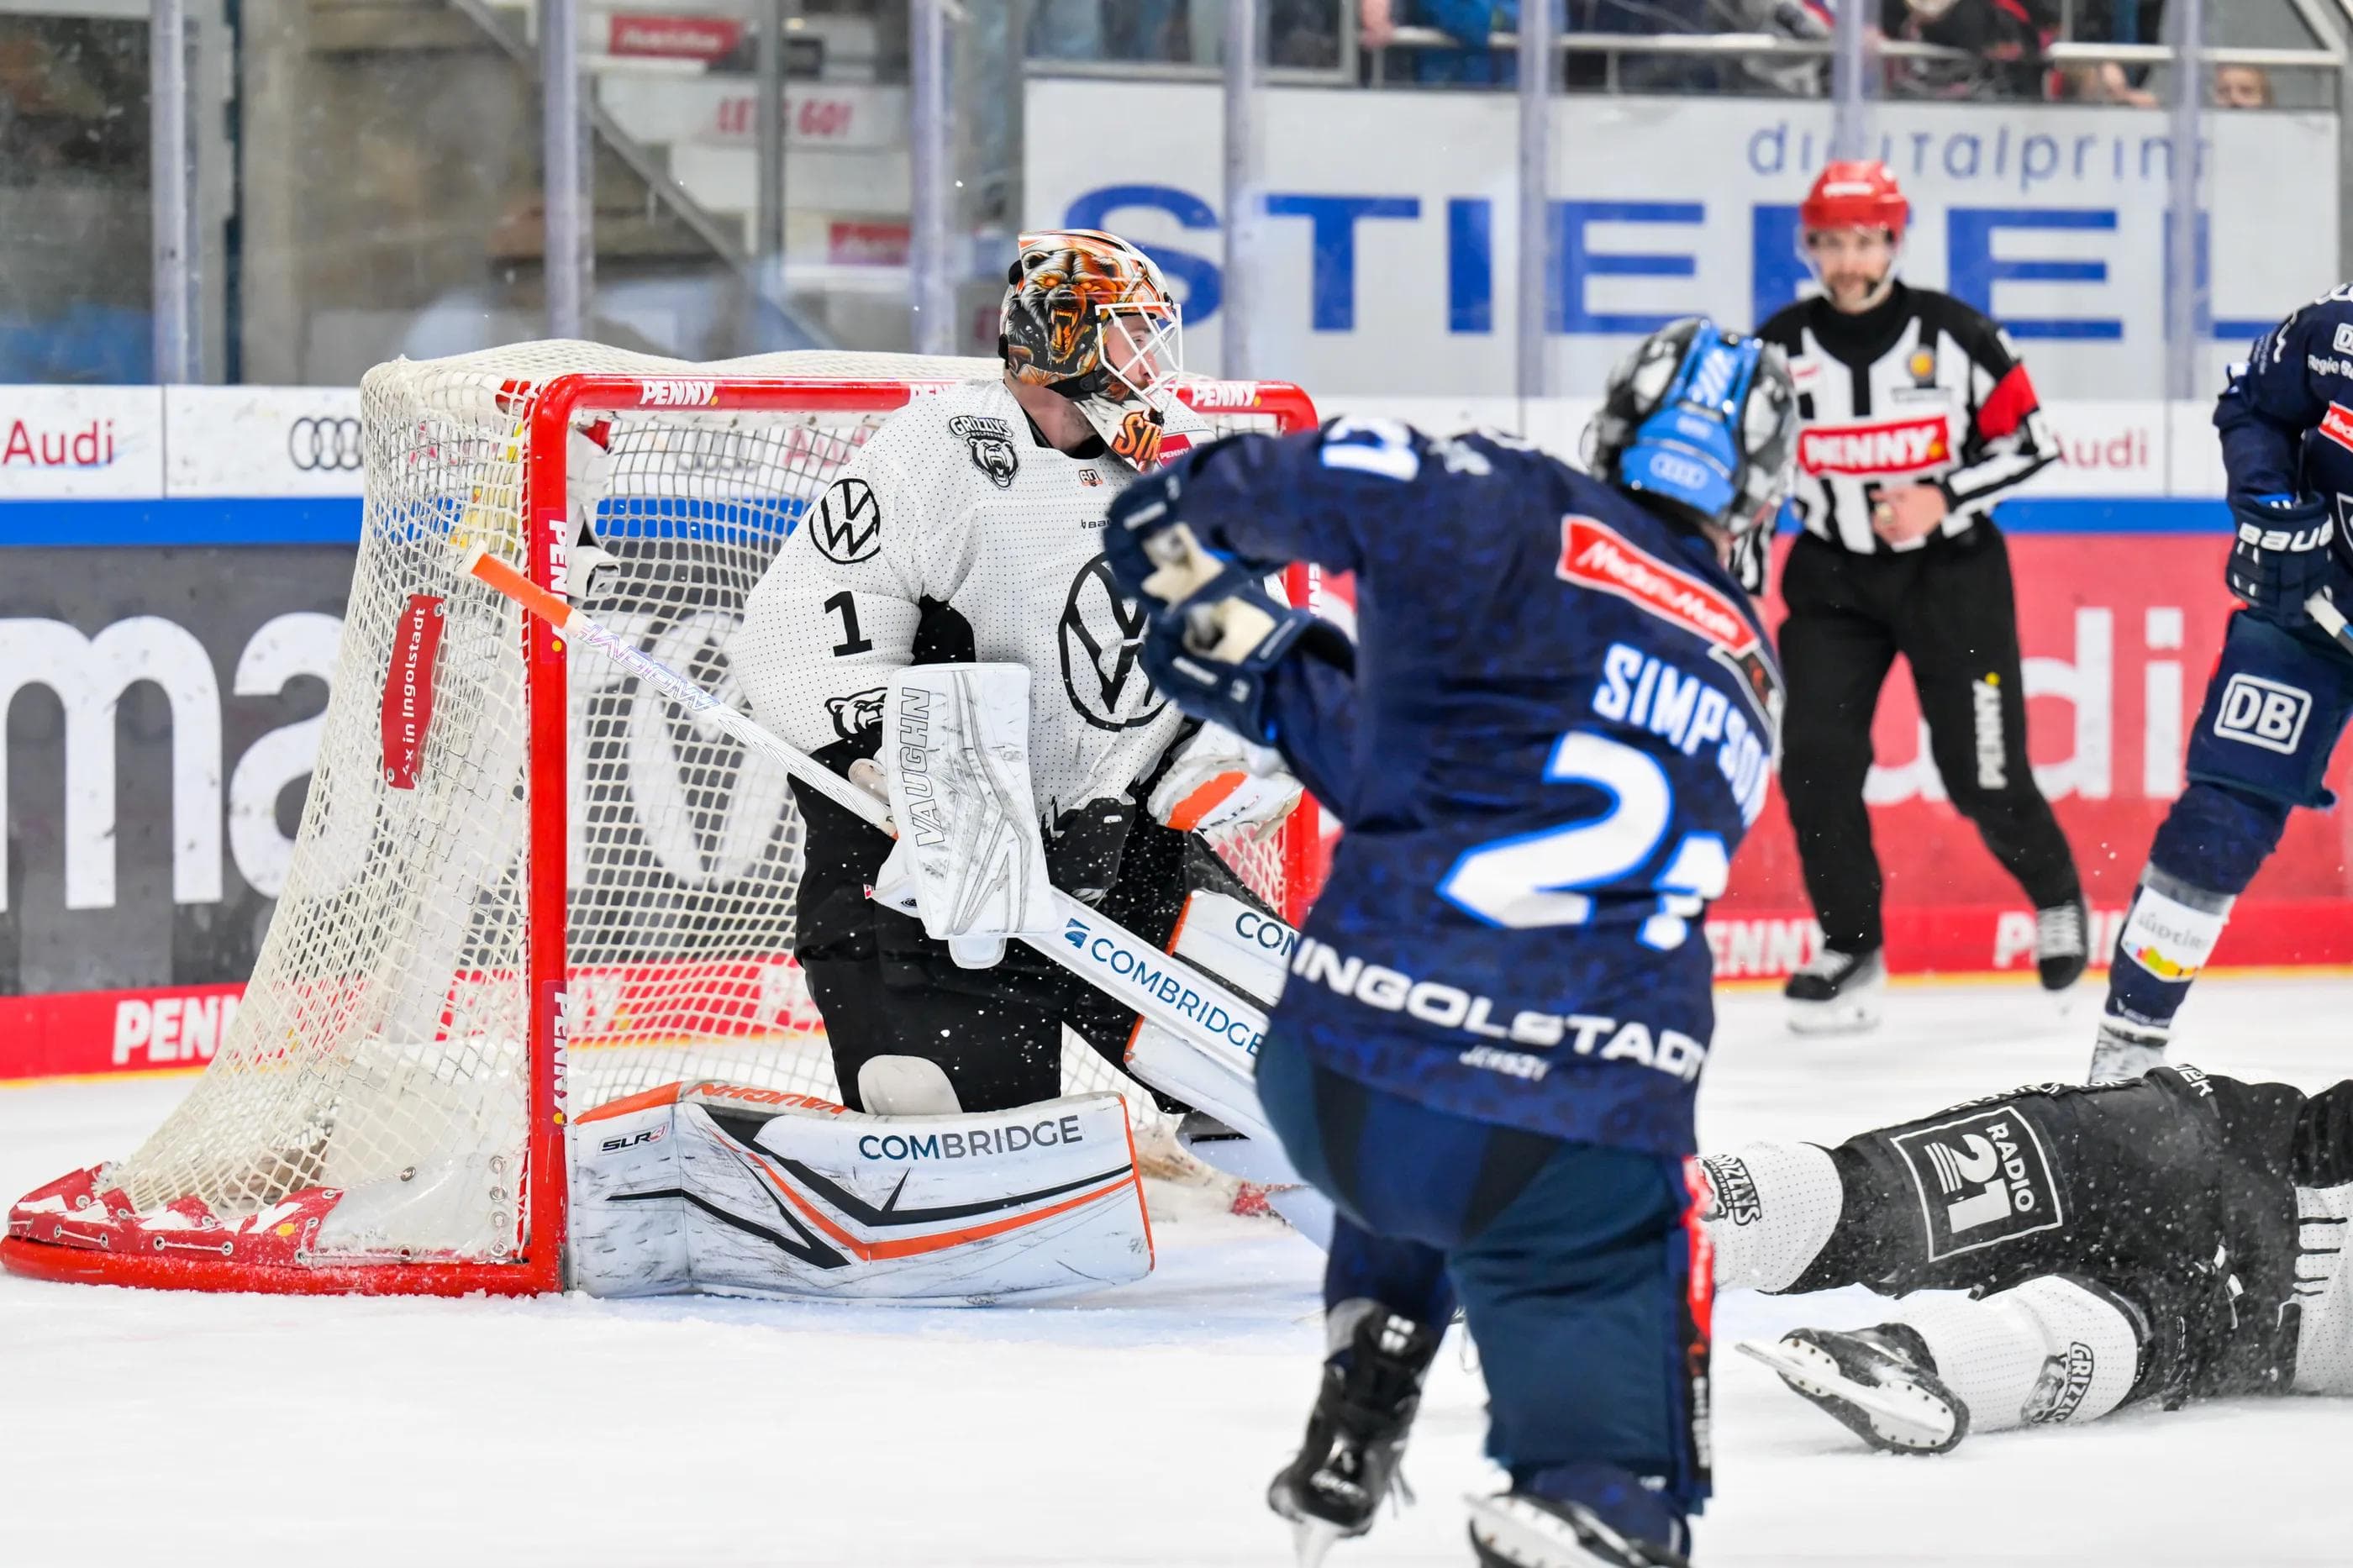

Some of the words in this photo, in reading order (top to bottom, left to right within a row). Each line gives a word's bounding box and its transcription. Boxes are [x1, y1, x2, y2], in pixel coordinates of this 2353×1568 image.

[3, 418, 113, 466] Audi
[823, 590, 873, 657] 1
[402, 607, 425, 718] Ingolstadt
[403, 723, 415, 744] in
[2224, 689, 2298, 743] DB
[900, 687, 945, 847] VAUGHN
[1092, 938, 1266, 1056] COMBRIDGE
[689, 1083, 850, 1114] VAUGHN
[858, 1115, 1084, 1161] COMBRIDGE
[1986, 1122, 2035, 1212] RADIO
[1924, 1134, 2012, 1234] 21
